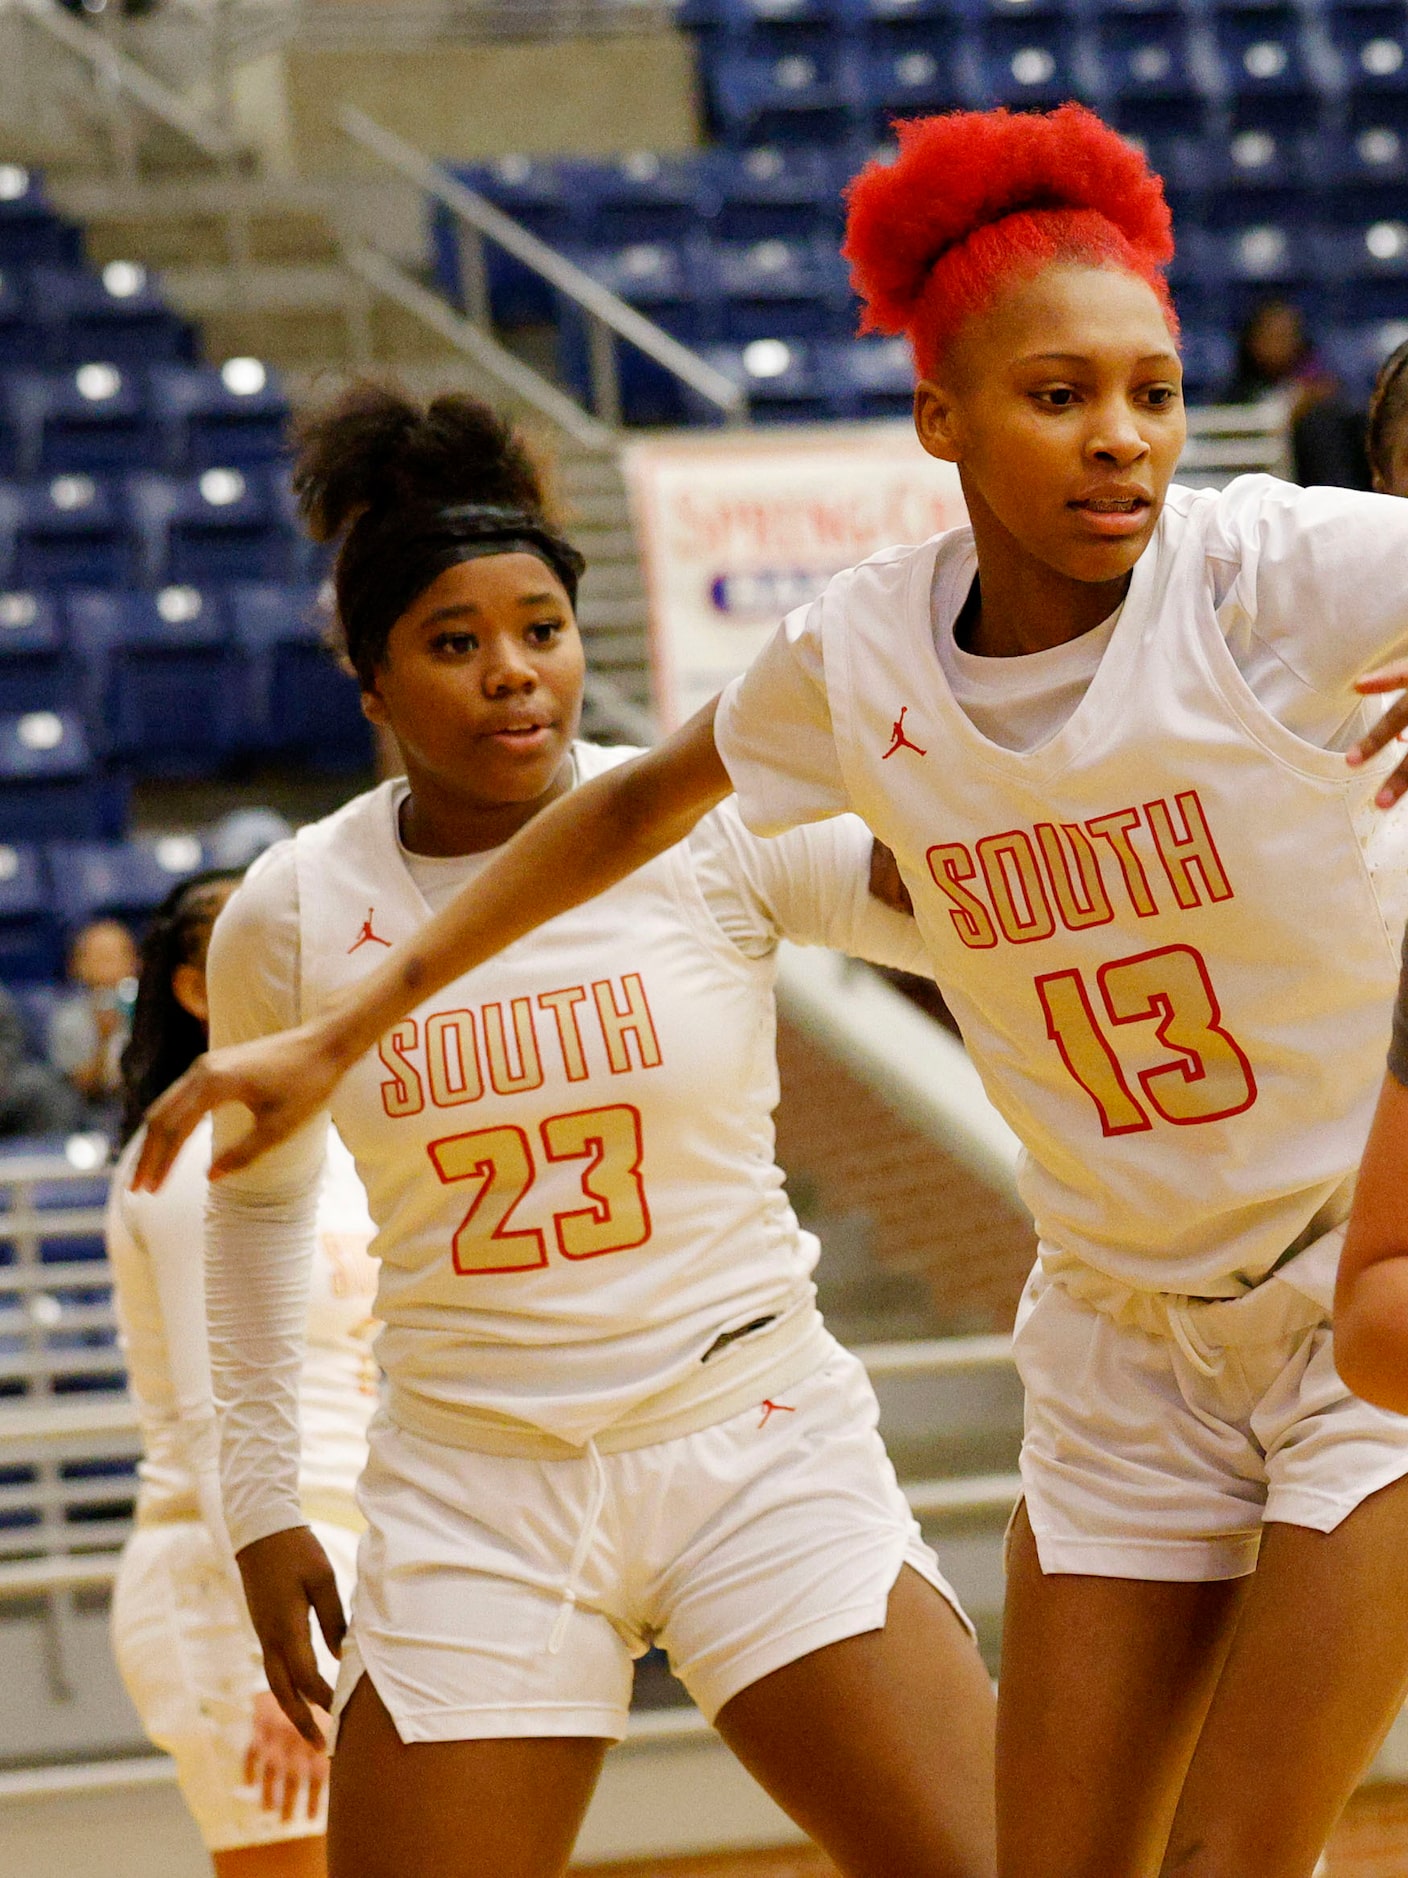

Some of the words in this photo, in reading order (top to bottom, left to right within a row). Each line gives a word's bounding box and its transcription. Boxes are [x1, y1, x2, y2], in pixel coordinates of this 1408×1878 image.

[926, 789, 1234, 949] SOUTH
[378, 972, 663, 1118] SOUTH
[1034, 943, 1257, 1137] 13
[426, 1103, 652, 1275] 23
